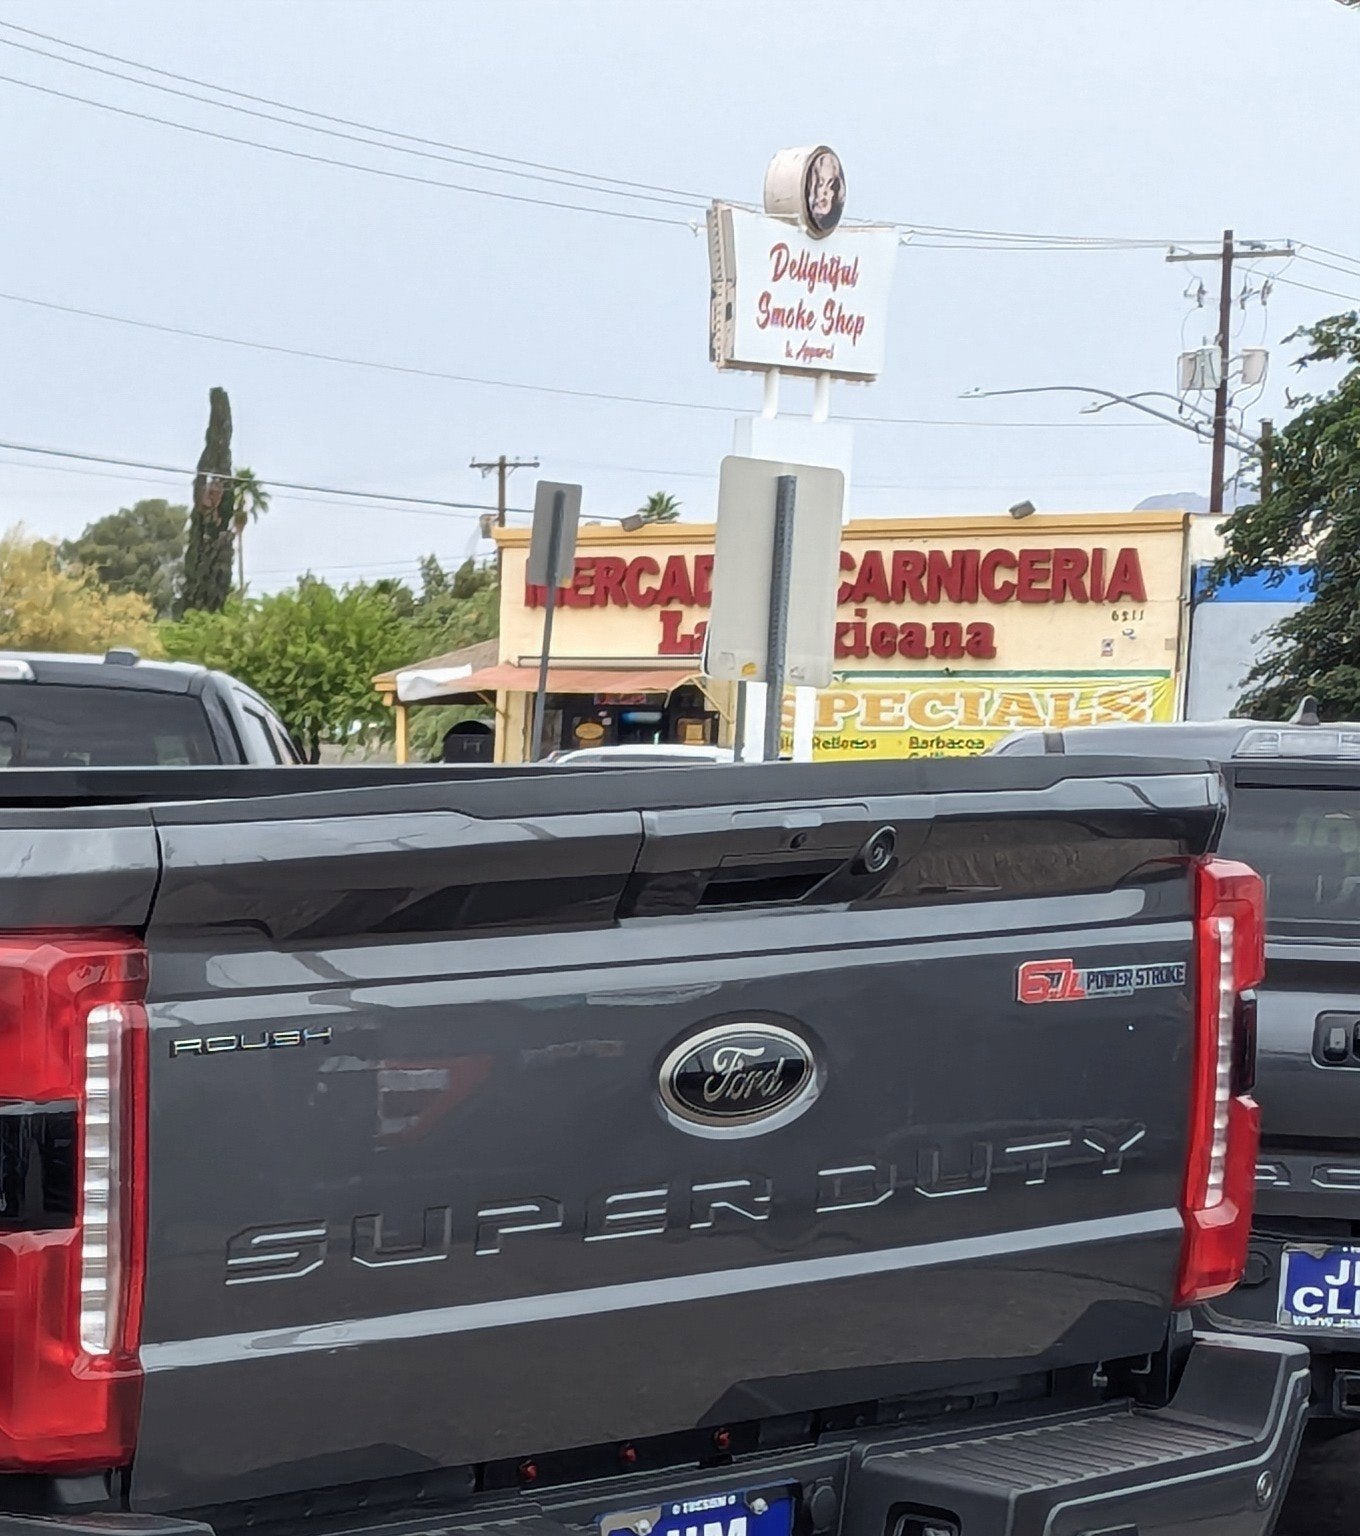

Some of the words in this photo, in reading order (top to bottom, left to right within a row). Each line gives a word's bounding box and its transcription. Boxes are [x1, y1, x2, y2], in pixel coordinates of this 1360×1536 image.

[770, 242, 859, 292] Delightful
[756, 291, 817, 330] Smoke
[820, 298, 865, 346] Shop
[525, 555, 714, 608] ERCAD
[1087, 968, 1133, 990] POWER
[1135, 964, 1185, 986] STROKE
[169, 1027, 332, 1057] ROUSH
[704, 1046, 784, 1103] Ford
[225, 1177, 772, 1286] SUPER
[815, 1123, 1147, 1213] DUTY
